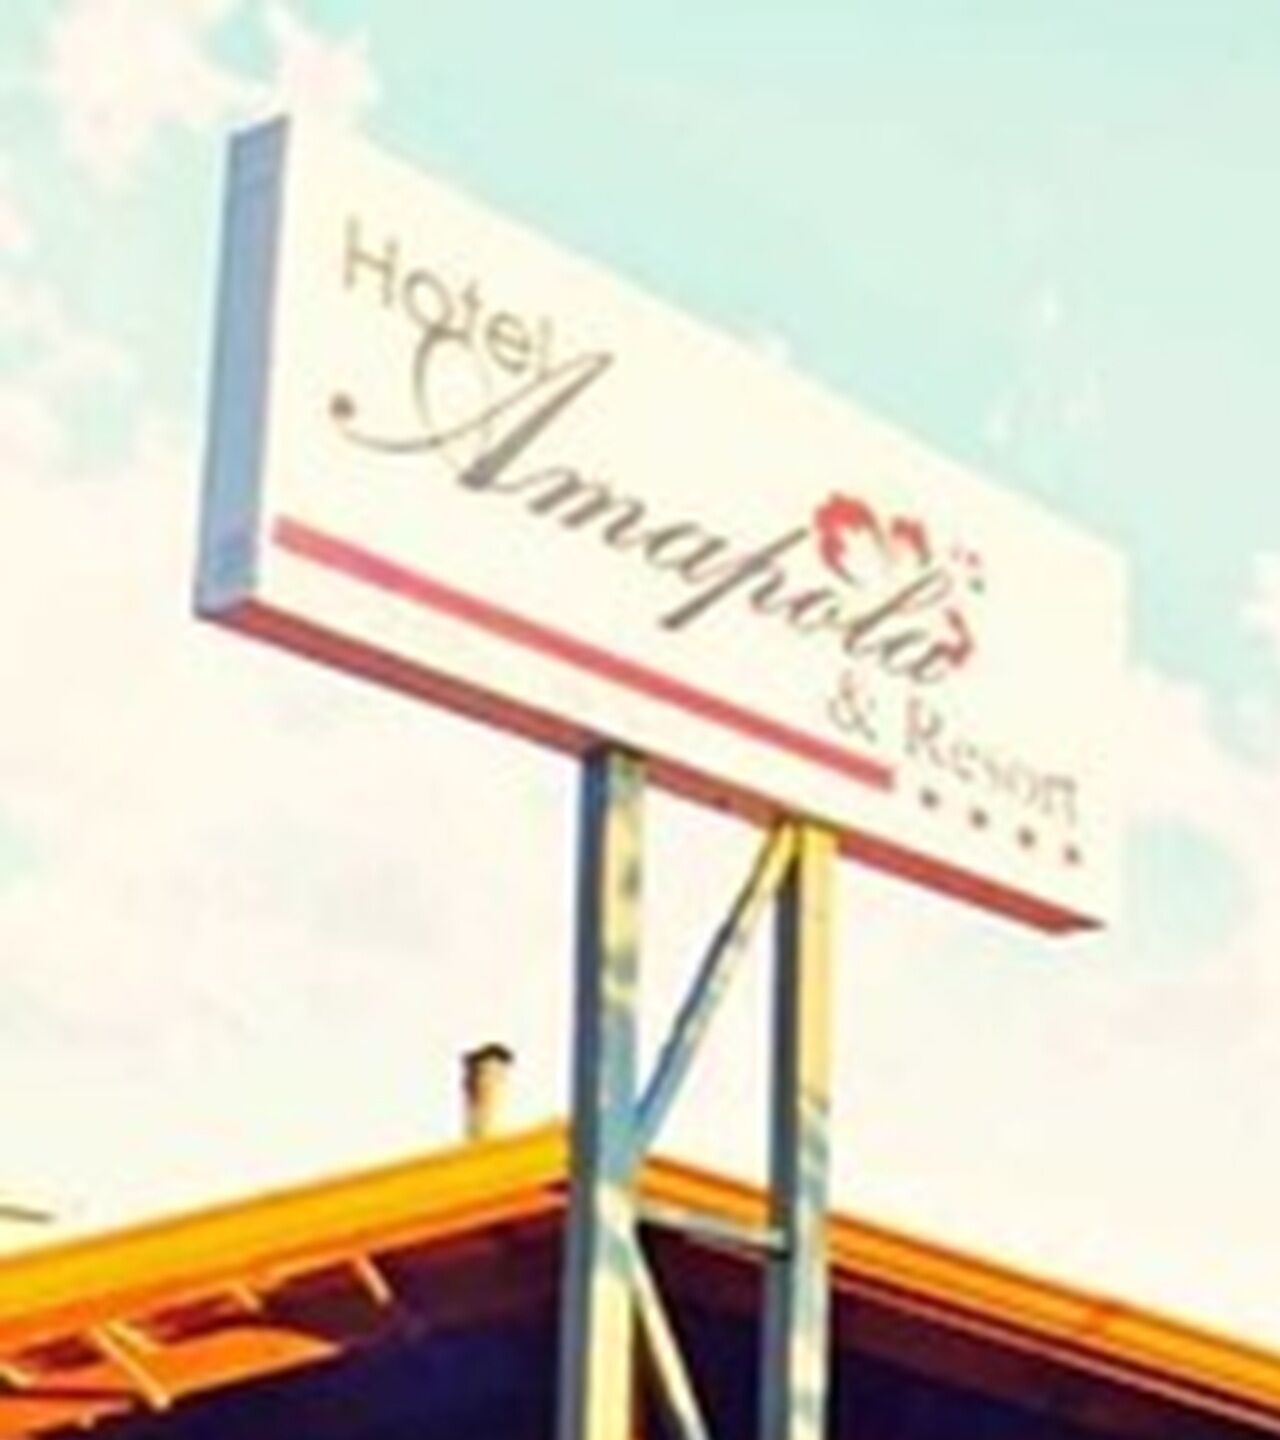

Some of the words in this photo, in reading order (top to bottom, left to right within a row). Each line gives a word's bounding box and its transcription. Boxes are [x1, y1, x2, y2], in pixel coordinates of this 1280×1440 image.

[342, 213, 555, 380] Hotel
[329, 327, 968, 685] Amapola
[826, 668, 879, 745] &
